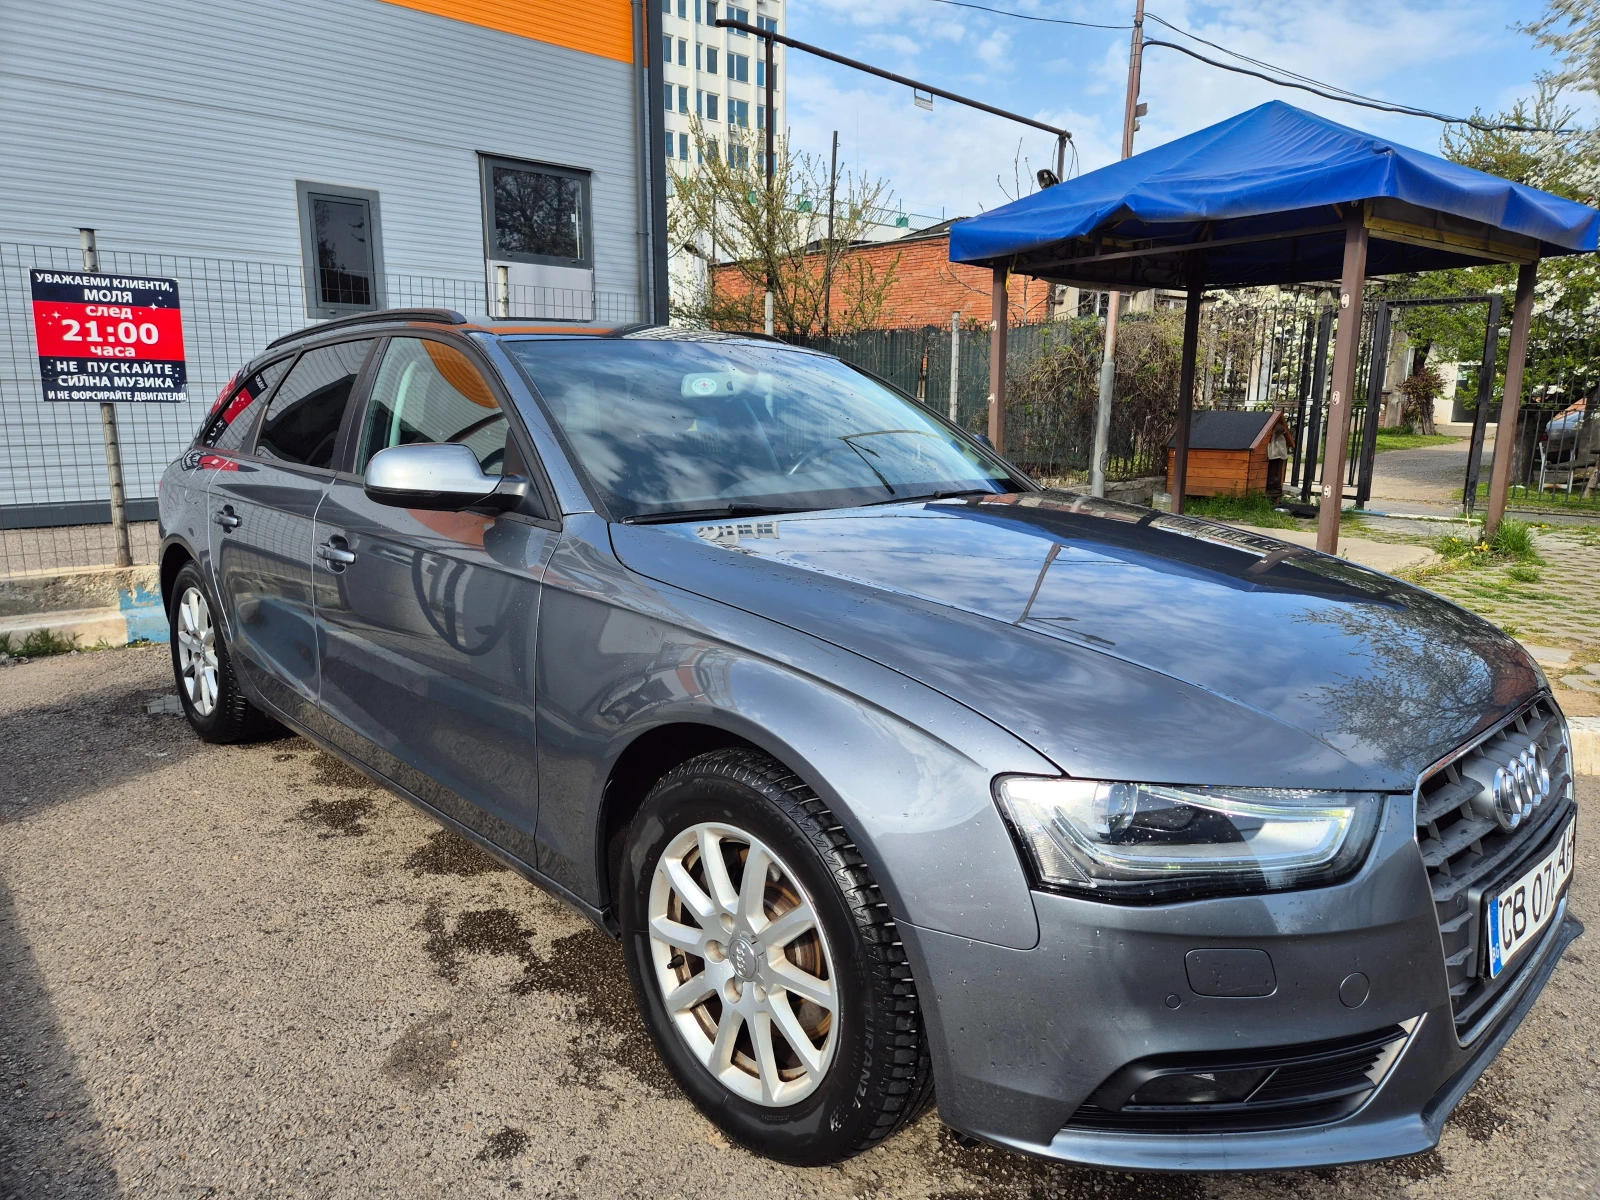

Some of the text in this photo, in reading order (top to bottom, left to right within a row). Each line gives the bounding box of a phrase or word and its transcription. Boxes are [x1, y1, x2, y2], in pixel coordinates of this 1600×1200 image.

[35, 272, 173, 292] УВАЖАЕМИ КЛИЕНТИ,
[83, 289, 133, 303] МОЛЯ
[85, 305, 133, 320] след
[61, 318, 159, 345] 21:00
[90, 345, 136, 357] часа
[56, 361, 173, 375] НЕ ПУСКАЙТЕ
[57, 375, 174, 388] СИЛНА МУЗИКА
[47, 389, 187, 402] И НЕ ФОРСИРАЙТЕ ДВИГАТЕЛЯ!
[1501, 885, 1527, 951] CB
